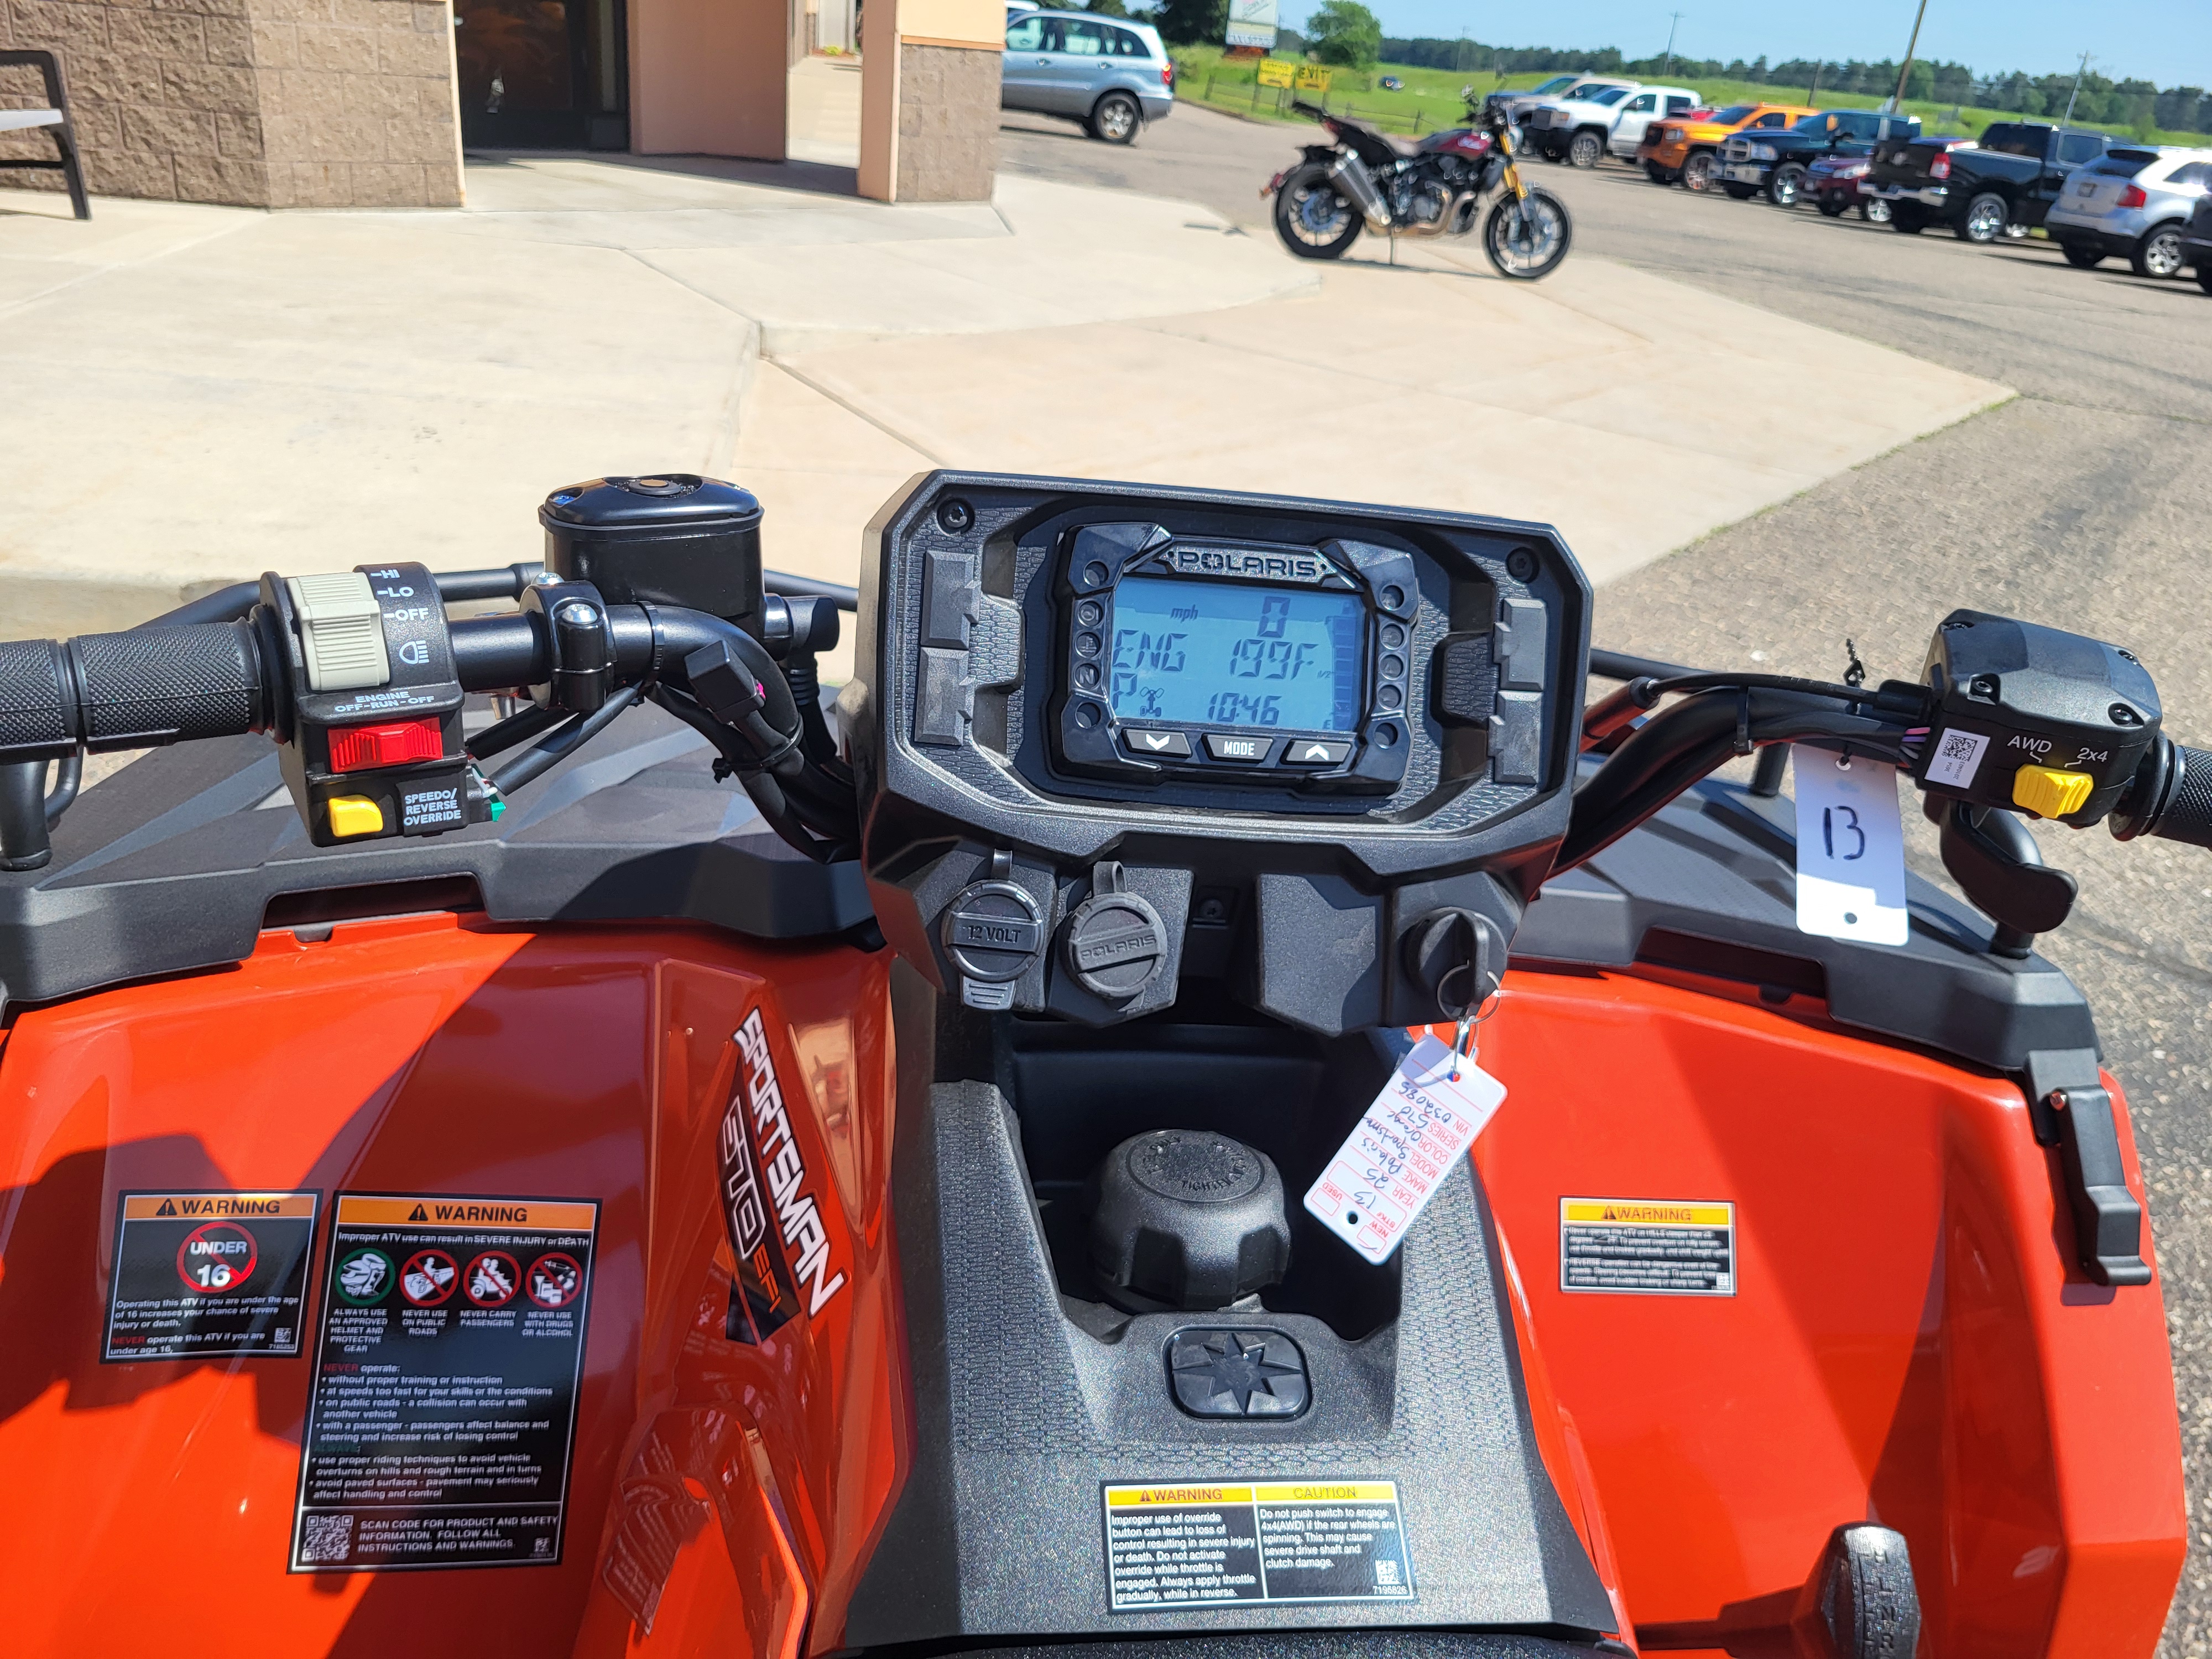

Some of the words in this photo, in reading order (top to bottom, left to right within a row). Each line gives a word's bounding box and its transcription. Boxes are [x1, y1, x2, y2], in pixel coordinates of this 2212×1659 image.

[1178, 551, 1316, 577] POLARIS
[388, 587, 414, 597] LO
[395, 608, 428, 621] OFF
[1171, 605, 1198, 622] mph
[1258, 596, 1290, 638] 0
[1113, 629, 1188, 672] ENG
[1229, 639, 1319, 680] 199F
[354, 691, 410, 703] ENGINE
[1113, 672, 1137, 711] P
[1207, 692, 1282, 726] 10:46
[1223, 741, 1255, 757] MODE
[2006, 735, 2052, 753] AWD
[2077, 748, 2107, 763] 2x4
[405, 787, 457, 804] SPEEDO/
[406, 800, 458, 815] REVERSE
[404, 810, 462, 827] OVERRIDE
[1824, 805, 1865, 861] 13
[968, 925, 984, 939] 12
[986, 927, 1021, 943] VOLT
[1081, 934, 1157, 961] POLARIS
[1453, 1120, 1469, 1136] VIN
[1428, 1124, 1459, 1150] SERIES
[1361, 1138, 1402, 1175] Polaris
[1418, 1136, 1449, 1165] COLOR
[733, 1006, 845, 1320] SPORTSMAN
[1408, 1152, 1438, 1179] MODEL
[723, 1094, 766, 1260] 570
[1363, 1168, 1389, 1190] 25
[1401, 1170, 1427, 1194] MAKE
[1322, 1182, 1342, 1201] USED
[1393, 1185, 1413, 1209] YEAR
[182, 1199, 280, 1214] WARNING
[1618, 1207, 1692, 1221] WARNING
[435, 1206, 528, 1223] WARNING
[1369, 1220, 1389, 1238] NEW
[338, 1232, 381, 1244] Improper
[381, 1233, 401, 1243] ATV
[402, 1235, 419, 1243] use
[420, 1235, 436, 1244] can
[474, 1235, 512, 1245] SEVERE
[513, 1237, 547, 1247] INJURY
[558, 1237, 589, 1247] DEATH
[190, 1241, 247, 1254] UNDER
[197, 1264, 231, 1287] 16
[753, 1243, 781, 1313] EFI
[117, 1301, 160, 1310] Operating
[180, 1298, 199, 1307] ATV
[207, 1298, 223, 1307] you
[241, 1296, 267, 1305] under
[268, 1296, 281, 1304] the
[283, 1297, 299, 1306] age
[115, 1311, 124, 1319] of
[127, 1310, 137, 1318] 16
[139, 1310, 182, 1318] increases
[184, 1309, 203, 1318] your
[239, 1306, 249, 1314] of
[250, 1307, 279, 1315] severe
[113, 1321, 139, 1331] injury
[111, 1336, 145, 1344] NEVER
[147, 1335, 183, 1345] operate
[204, 1333, 223, 1341] ATV
[232, 1333, 249, 1343] you
[139, 1346, 158, 1354] age
[1153, 1488, 1222, 1501] WARNING
[1294, 1486, 1357, 1499] CAUTION
[1112, 1515, 1153, 1527] Improper
[1155, 1515, 1172, 1524] use
[1173, 1512, 1183, 1524] of
[1185, 1512, 1223, 1523] override
[1260, 1509, 1274, 1519] Do
[1275, 1509, 1291, 1519] not
[1291, 1507, 1314, 1520] push
[1315, 1507, 1343, 1519] switch
[1345, 1507, 1355, 1517] to
[1357, 1509, 1388, 1519] engage
[1113, 1527, 1142, 1537] button
[1144, 1527, 1161, 1536] can
[1163, 1525, 1183, 1536] lead
[1185, 1525, 1194, 1535] to
[1196, 1525, 1215, 1535] loss
[1217, 1524, 1227, 1534] of
[1261, 1520, 1305, 1533] 4x4(AWD)
[1306, 1520, 1313, 1531] if
[1314, 1520, 1329, 1531] the
[1350, 1519, 1381, 1530] wheels
[1113, 1539, 1146, 1550] control
[1147, 1538, 1187, 1550] resulting
[1188, 1537, 1197, 1547] in
[1198, 1538, 1230, 1547] severe
[1230, 1536, 1255, 1548] injury
[1304, 1532, 1324, 1543] This
[1326, 1533, 1344, 1544] may
[1114, 1554, 1124, 1563] or
[1156, 1551, 1171, 1561] Do
[1172, 1551, 1188, 1561] not
[1190, 1550, 1227, 1560] activate
[1264, 1547, 1295, 1556] severe
[1296, 1545, 1319, 1556] drive
[1320, 1545, 1343, 1554] shaft
[1344, 1543, 1363, 1554] and
[1115, 1564, 1153, 1575] override
[1154, 1563, 1180, 1574] while
[1180, 1562, 1214, 1573] throttle
[1215, 1562, 1224, 1572] is
[1266, 1558, 1295, 1569] clutch
[1160, 1576, 1194, 1589] Always
[1195, 1574, 1221, 1587] apply
[1222, 1573, 1256, 1584] throttle
[1164, 1589, 1188, 1600] while
[1190, 1588, 1199, 1599] in
